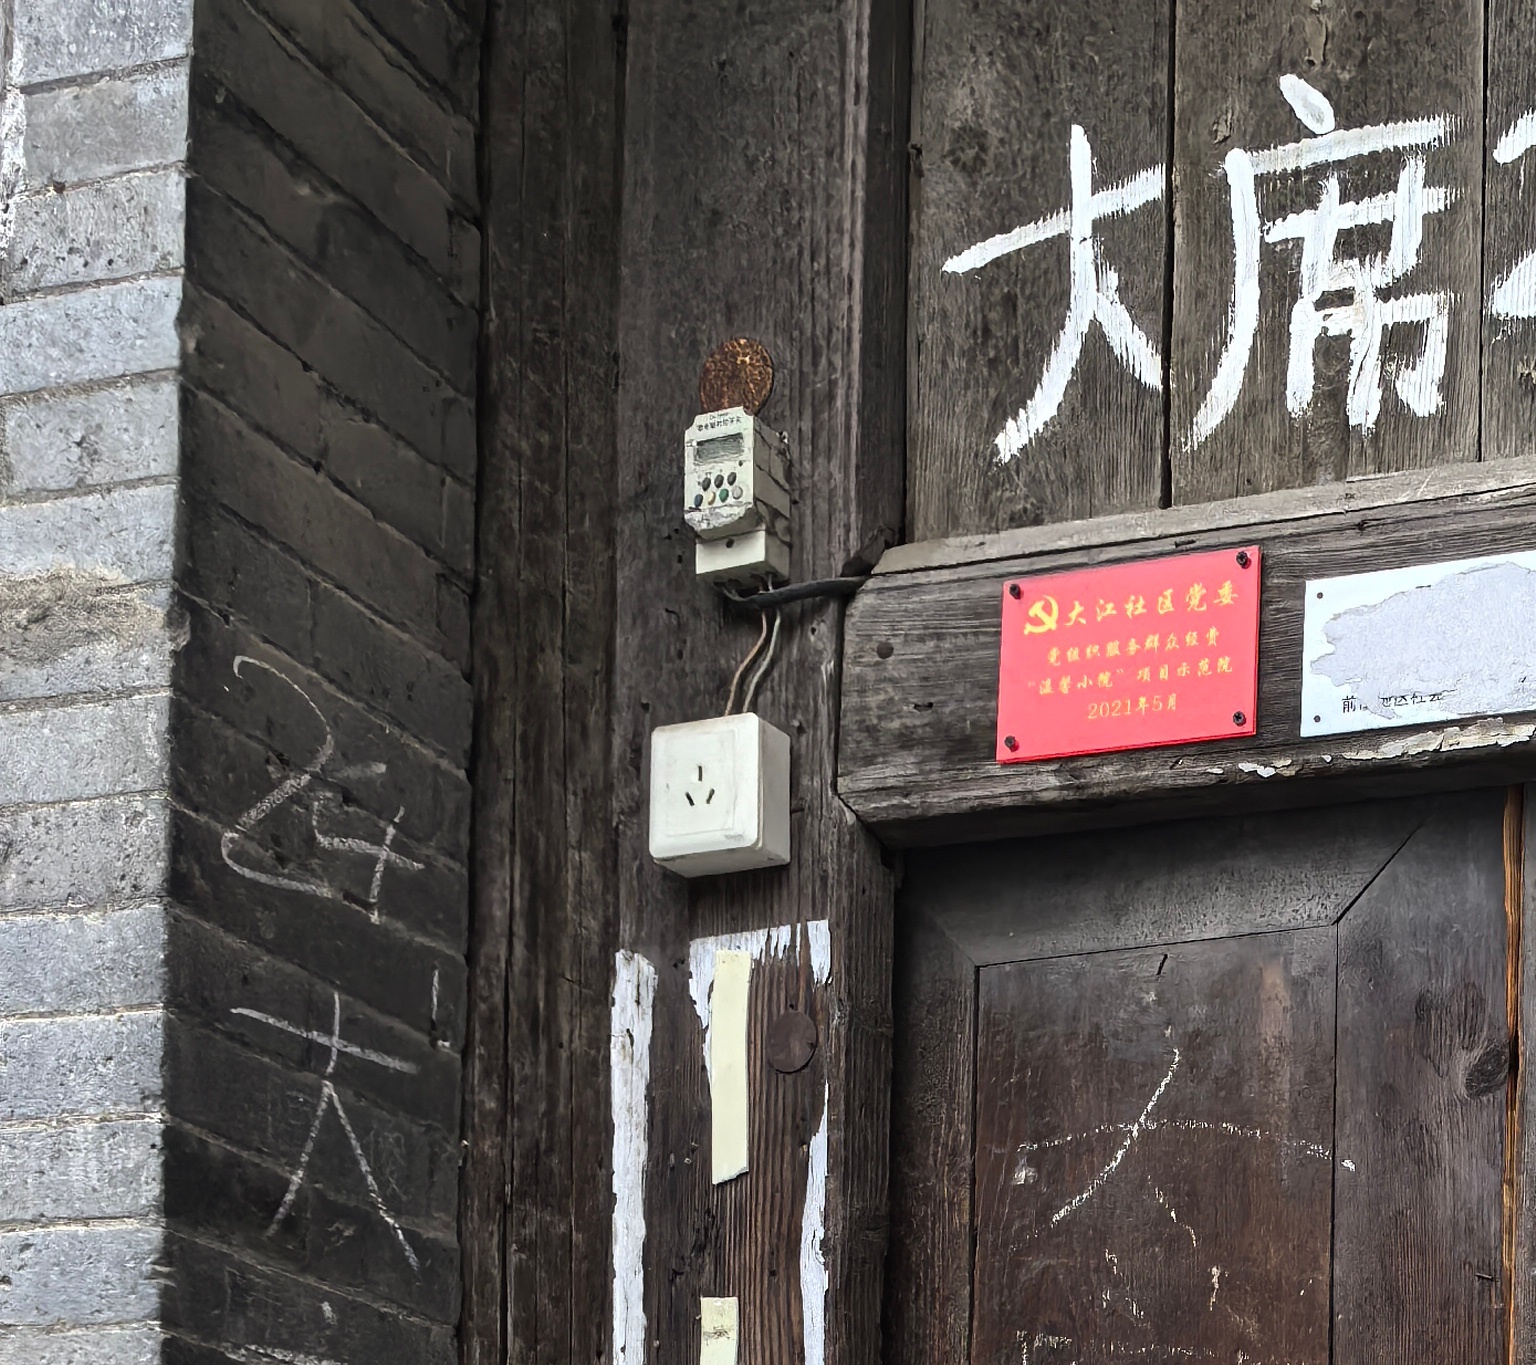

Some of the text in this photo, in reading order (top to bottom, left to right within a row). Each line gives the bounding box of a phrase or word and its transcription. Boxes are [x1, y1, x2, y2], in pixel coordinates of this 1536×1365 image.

[1064, 580, 1239, 627] 大江社区党委
[1047, 626, 1220, 667] 党组织服务群众经费
[1087, 693, 1177, 720] 2021年5月
